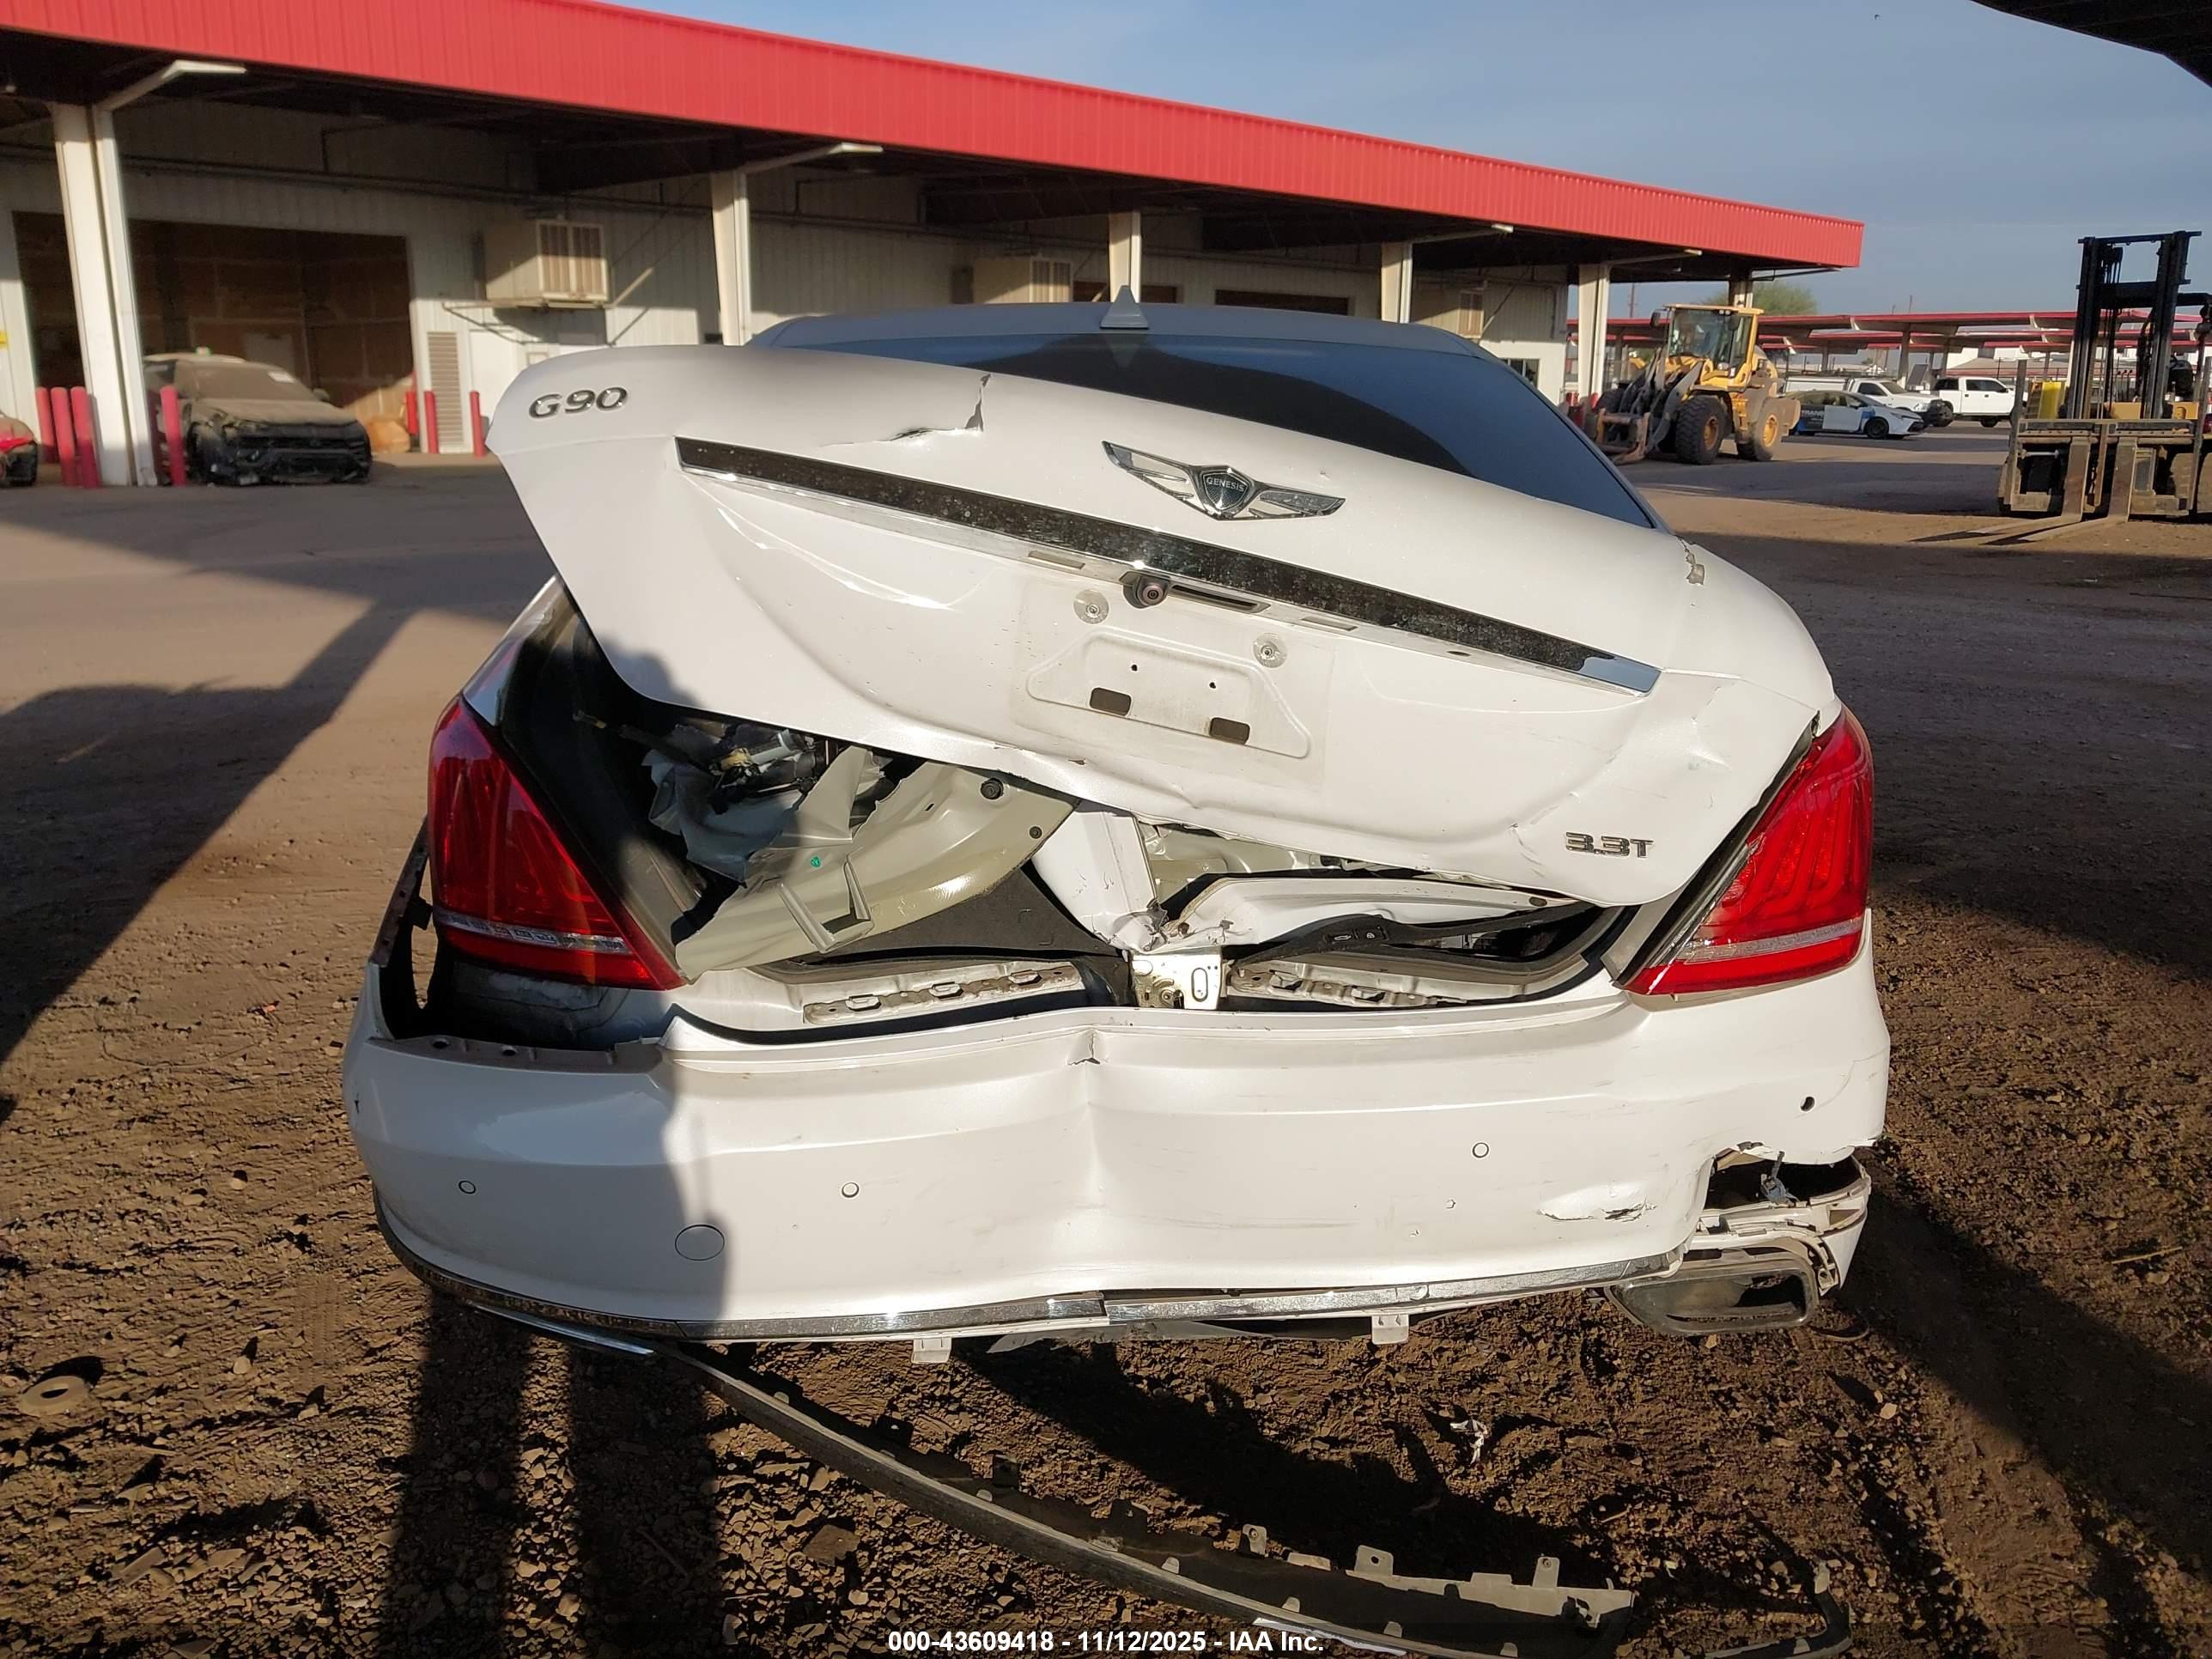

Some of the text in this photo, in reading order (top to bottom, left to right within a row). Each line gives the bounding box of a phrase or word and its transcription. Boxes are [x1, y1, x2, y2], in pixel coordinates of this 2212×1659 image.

[528, 386, 628, 419] G90
[1206, 477, 1245, 492] GENESIS
[1565, 830, 1654, 859] 3.3T
